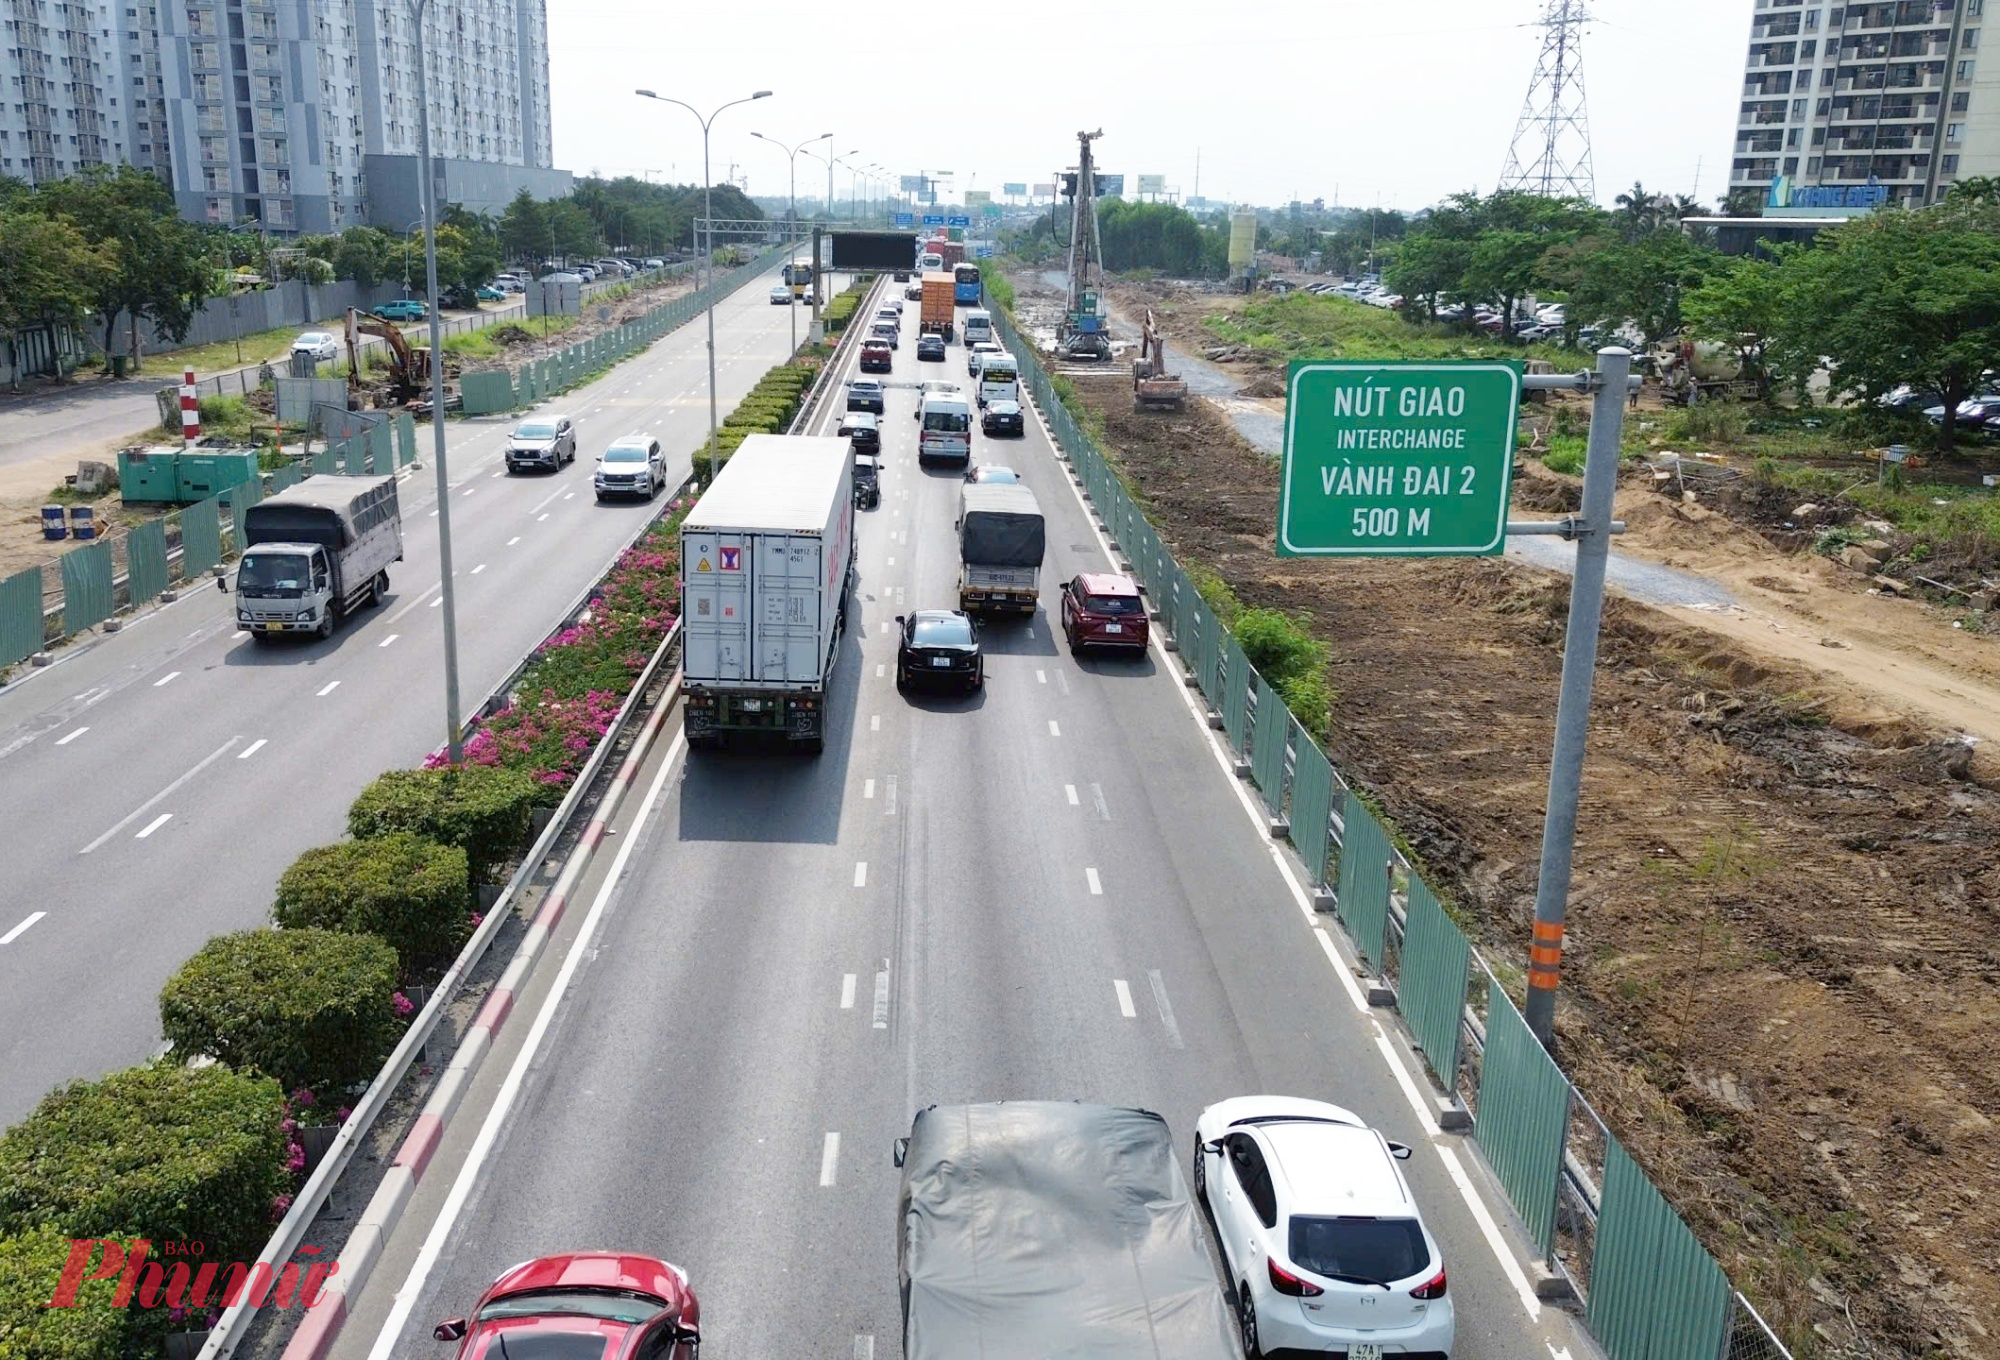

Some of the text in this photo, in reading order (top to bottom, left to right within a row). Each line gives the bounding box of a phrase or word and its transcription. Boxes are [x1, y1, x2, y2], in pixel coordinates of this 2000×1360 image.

[1333, 376, 1465, 417] NÚT GIAO
[1337, 429, 1466, 449] INTERCHANGE
[1321, 457, 1476, 495] VÀNH ĐAI 2
[1352, 507, 1431, 536] 500 M
[1356, 1344, 1374, 1356] 47A
